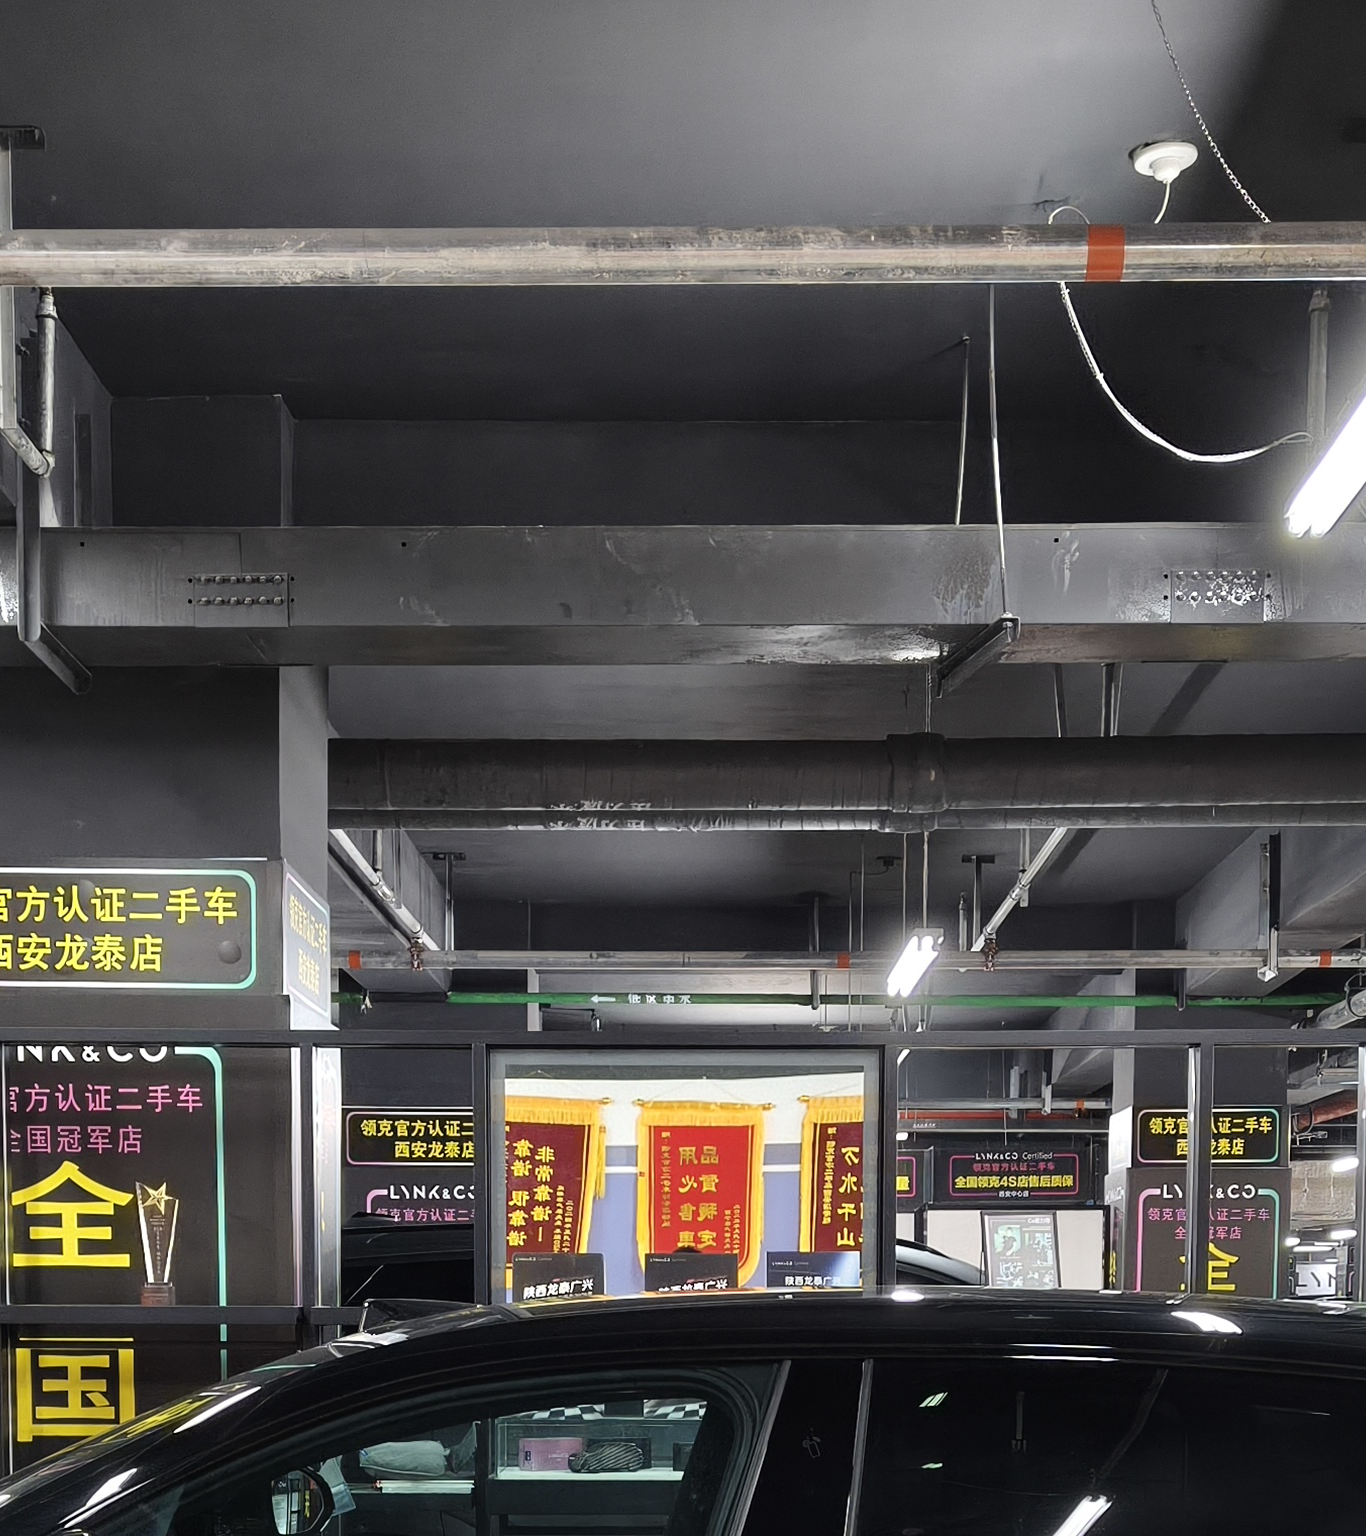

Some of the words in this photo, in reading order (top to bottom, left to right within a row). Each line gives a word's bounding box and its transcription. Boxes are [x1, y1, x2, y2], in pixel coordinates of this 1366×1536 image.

[394, 1141, 475, 1158] 西安龙泰店
[975, 1152, 1019, 1160] LYNK&CO
[1022, 1152, 1053, 1160] Certified
[954, 1175, 1074, 1188] 全国领克4S店售后质保
